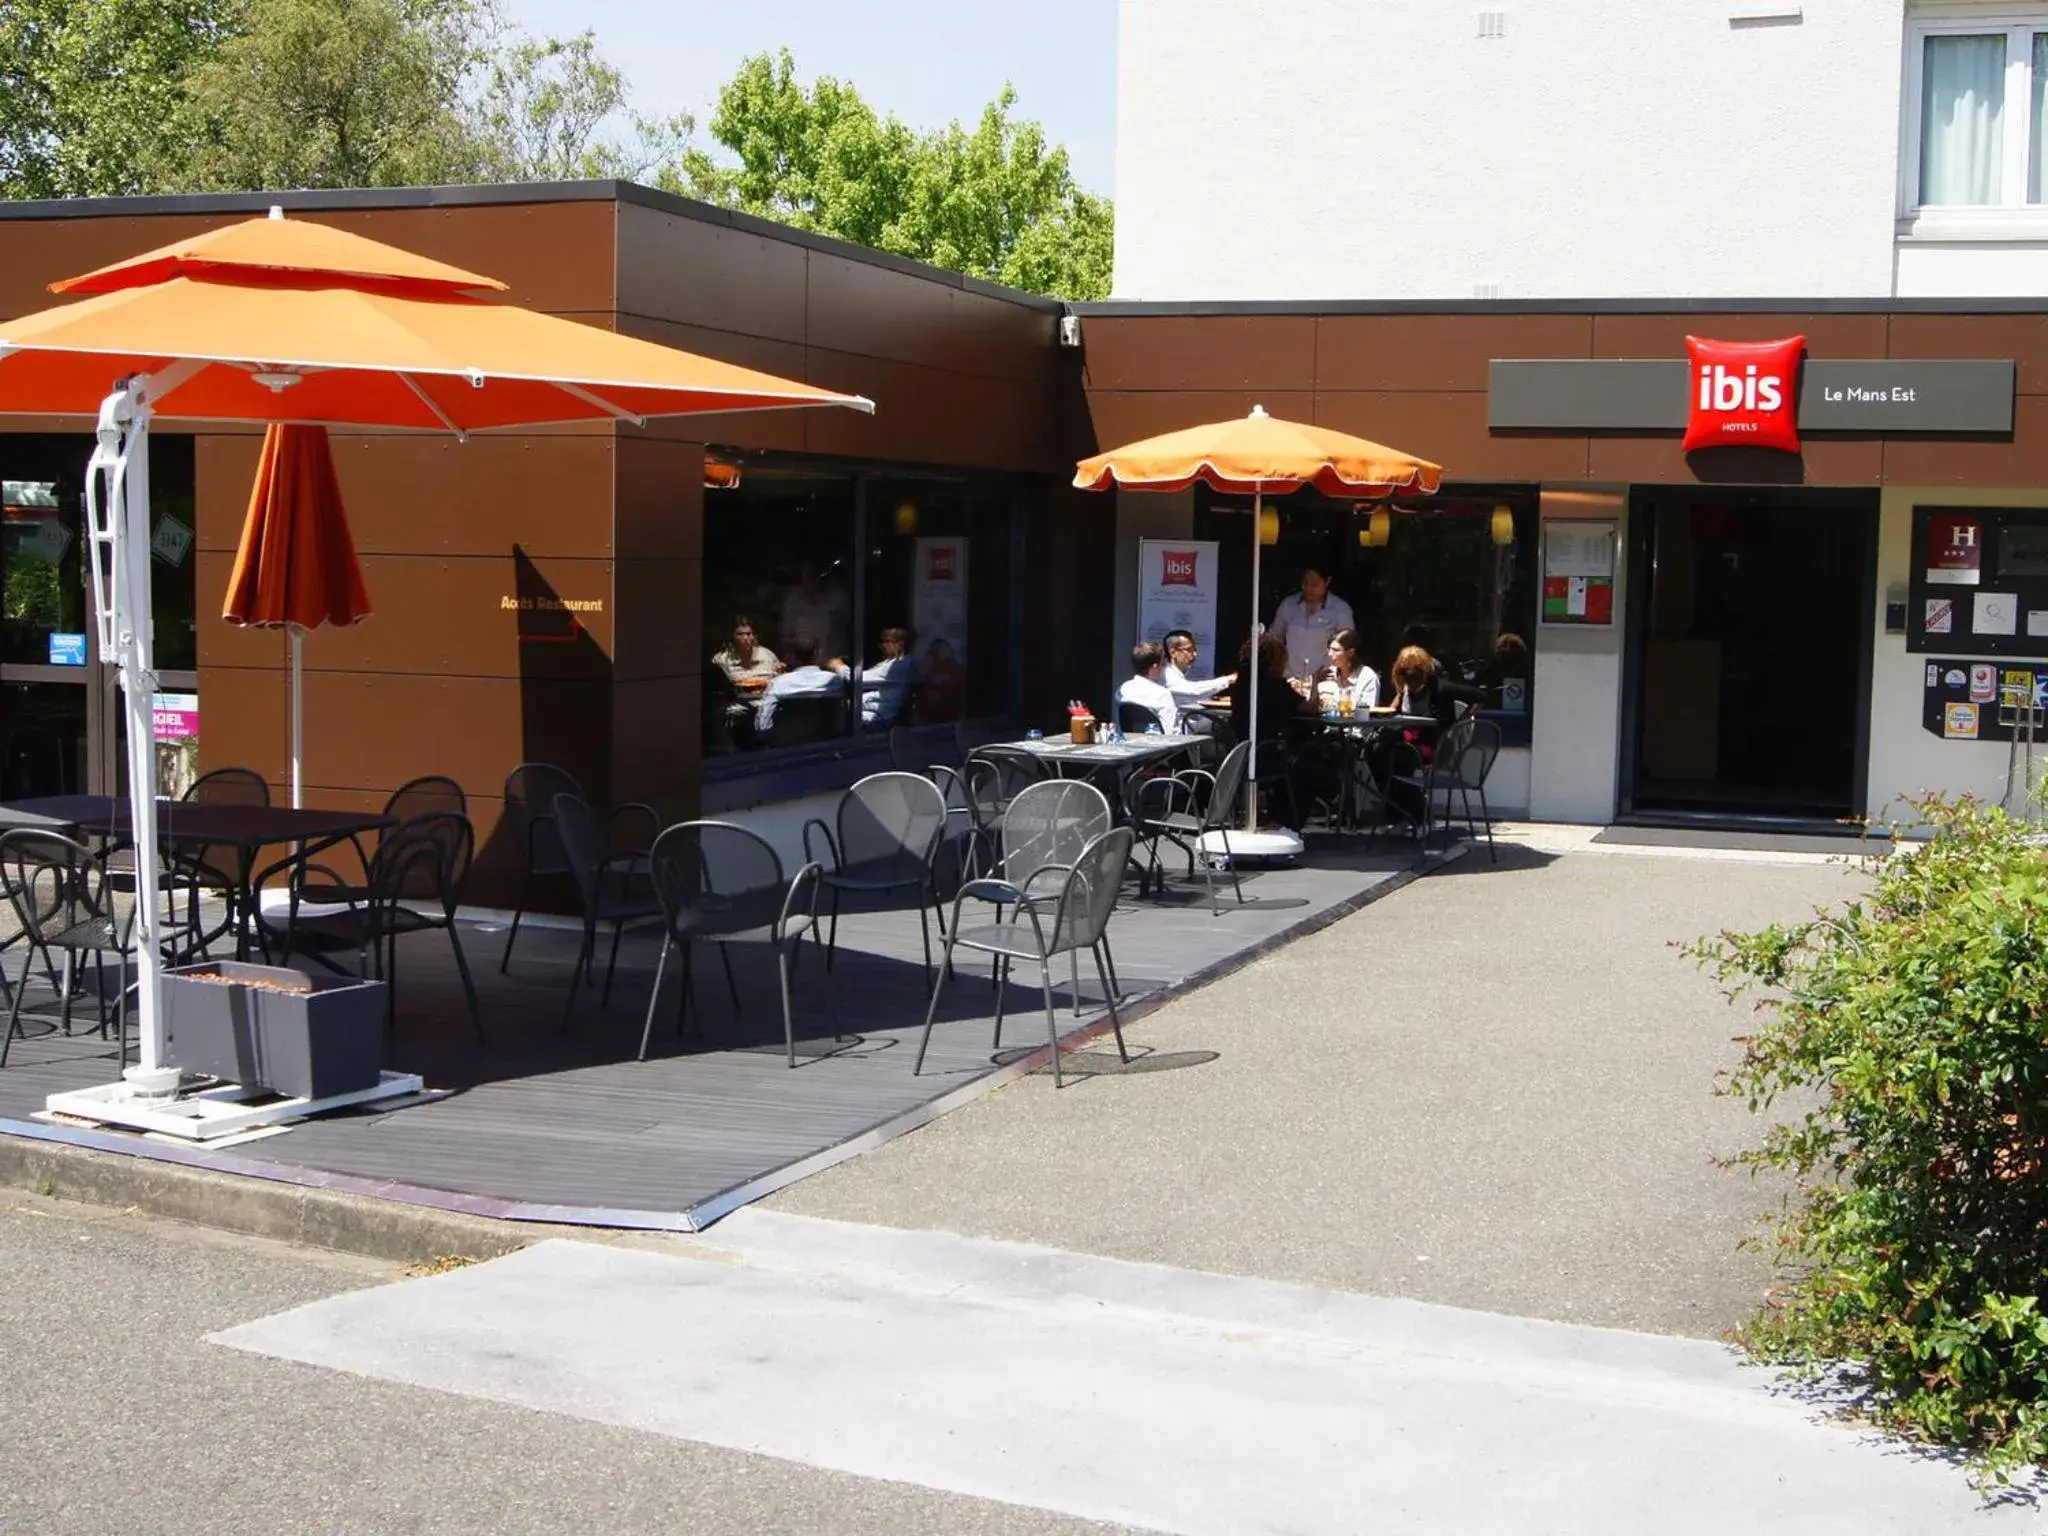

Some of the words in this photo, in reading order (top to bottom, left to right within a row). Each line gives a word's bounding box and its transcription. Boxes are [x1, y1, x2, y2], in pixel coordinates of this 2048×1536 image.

[1699, 364, 1783, 412] ibis
[1825, 386, 1843, 401] Le
[1847, 387, 1888, 401] Mans
[1891, 387, 1916, 402] Est
[1721, 422, 1758, 432] HOTELS
[1952, 526, 1977, 546] H
[1166, 560, 1193, 575] ibis
[536, 597, 604, 612] Restaurant
